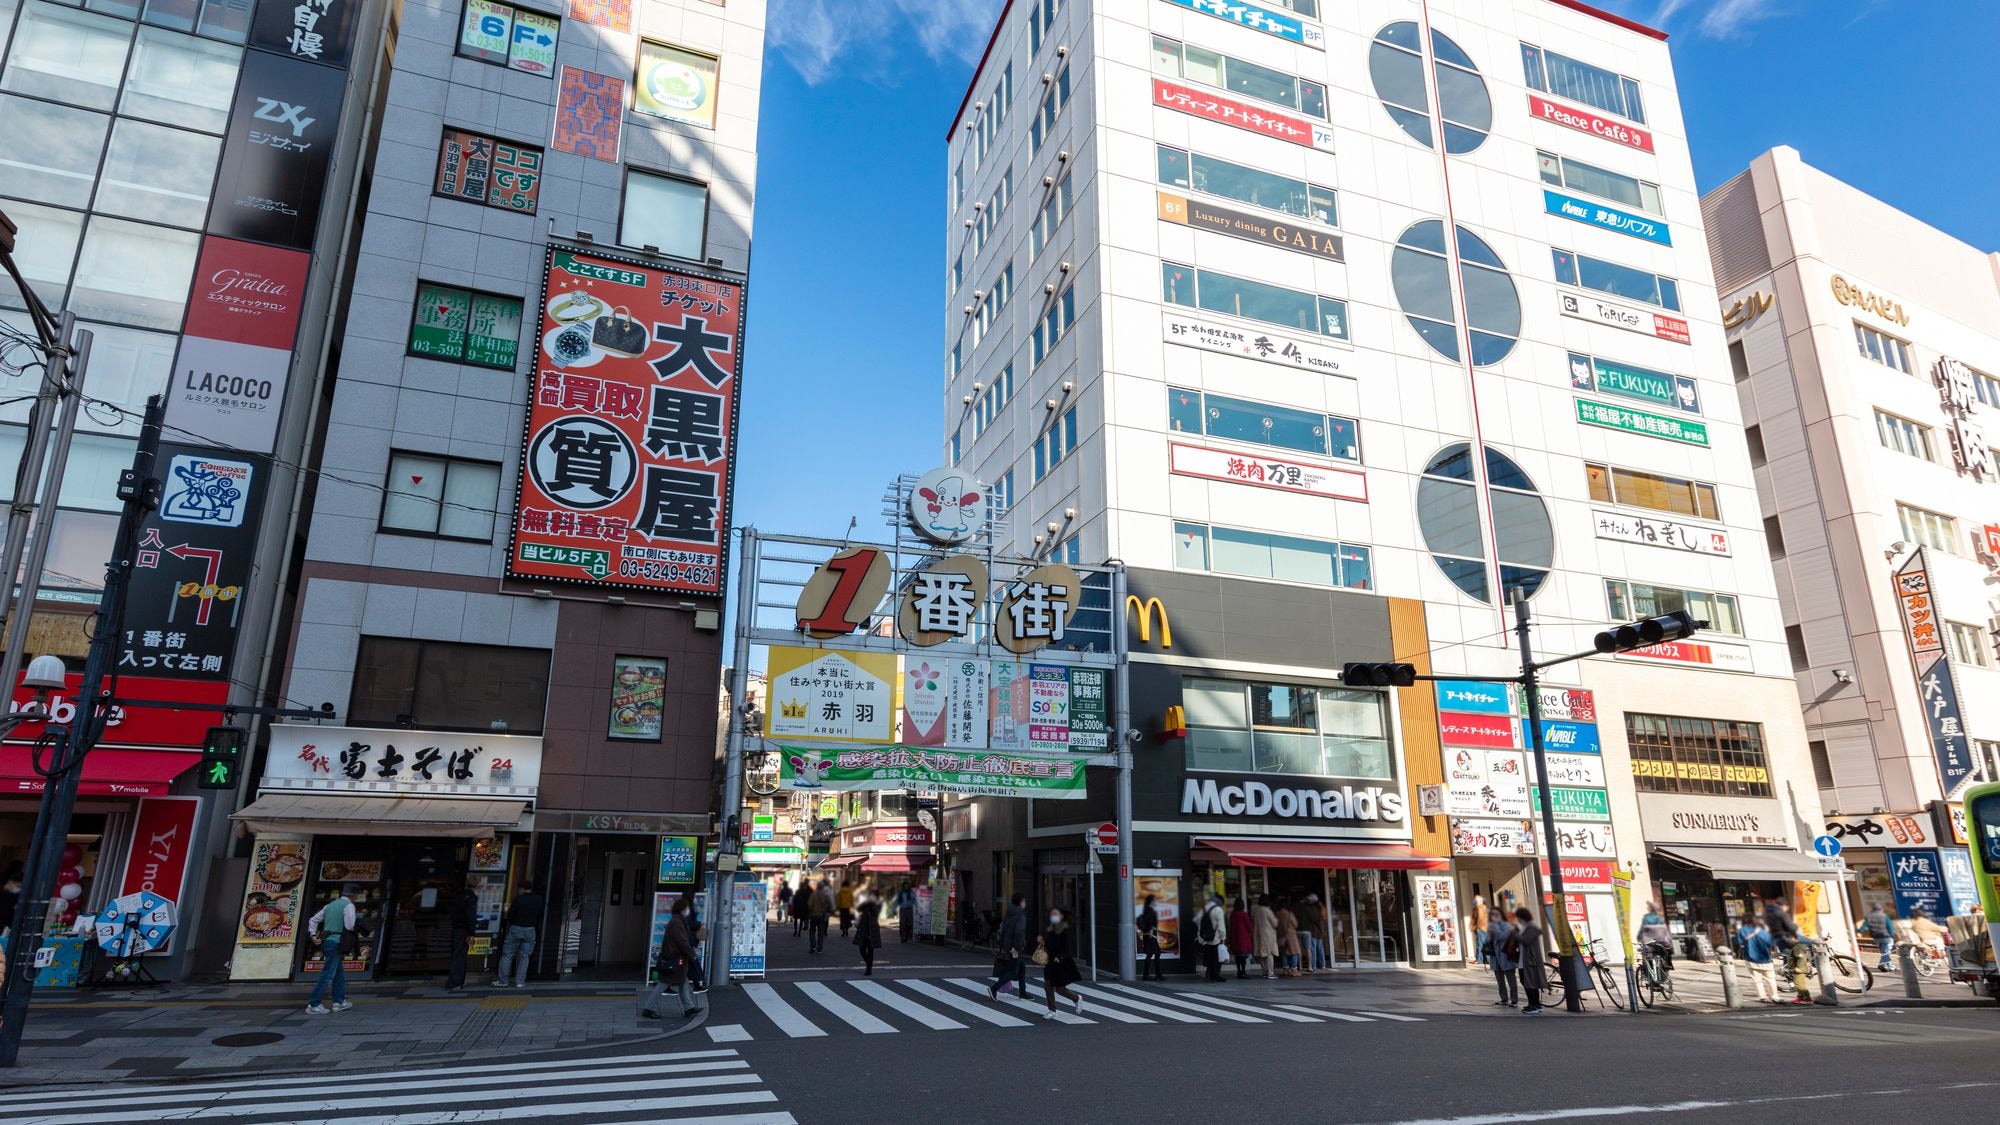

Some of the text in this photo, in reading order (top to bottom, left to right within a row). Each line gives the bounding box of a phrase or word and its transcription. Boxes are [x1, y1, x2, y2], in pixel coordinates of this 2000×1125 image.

[1305, 29, 1322, 41] 8F
[253, 96, 316, 137] ZXY
[1162, 89, 1306, 137] レディース アートネイチャー
[1542, 102, 1629, 143] Peace Café
[248, 130, 311, 153] ジザイ
[1314, 131, 1332, 143] 7F
[441, 142, 462, 194] 赤羽東口店
[463, 138, 490, 201] 大黒屋
[1165, 201, 1182, 214] 6F
[1195, 209, 1337, 255] Luxury dining GAIA
[1594, 210, 1657, 237] 東急リバブル
[567, 260, 643, 285] ここです 5F
[662, 274, 732, 298] 赤羽東口店
[207, 293, 287, 311] エステティックサロン
[660, 290, 730, 317] チケット
[1172, 323, 1188, 336] 5F
[412, 339, 516, 368] 03-5939-7194
[185, 370, 273, 400] LACOCO
[1609, 371, 1668, 398] FUKUYA
[184, 393, 267, 411] ルミクス脱毛サロン
[631, 313, 733, 546] 大黒屋
[543, 424, 623, 502] 質
[1226, 457, 1304, 488] 焼肉万里
[521, 506, 630, 543] 無料査定
[1635, 518, 1698, 551] ねぎし
[136, 528, 165, 569] 入口
[622, 545, 717, 566] 南口側にもあります
[620, 559, 718, 586] 03-5249-4621
[1907, 595, 1936, 639] カツ丼
[118, 650, 223, 672] 入って左側
[817, 667, 849, 678] 本当に
[789, 676, 876, 692] 住みやすい街大賞
[1031, 681, 1067, 690] 赤羽エリアの
[1072, 671, 1102, 686] 赤羽法律
[821, 690, 844, 699] 2019
[1033, 688, 1065, 698] 不動産なら
[1072, 684, 1101, 699] 事務所
[1446, 690, 1499, 703] アートネイチャー
[1922, 673, 1964, 737] 大戸屋
[813, 727, 848, 735] ARUHI
[962, 700, 974, 743] 佐藤開発
[1442, 725, 1470, 736] レディース
[1590, 743, 1599, 752] 7F
[339, 740, 484, 780] 富士そば
[490, 757, 513, 770] 24
[836, 751, 1078, 780] 感染拡大防止徹底宣言
[1947, 767, 1967, 777] B1F
[1181, 778, 1404, 823] McDonald's
[588, 816, 623, 829] KSY
[1672, 812, 1760, 832] SUNMERRY'S
[886, 833, 926, 841] SUGIZAKI
[663, 853, 694, 862] スマイエ
[1896, 855, 1935, 878] 大戸屋
[1900, 880, 1936, 889] OOTOYA
